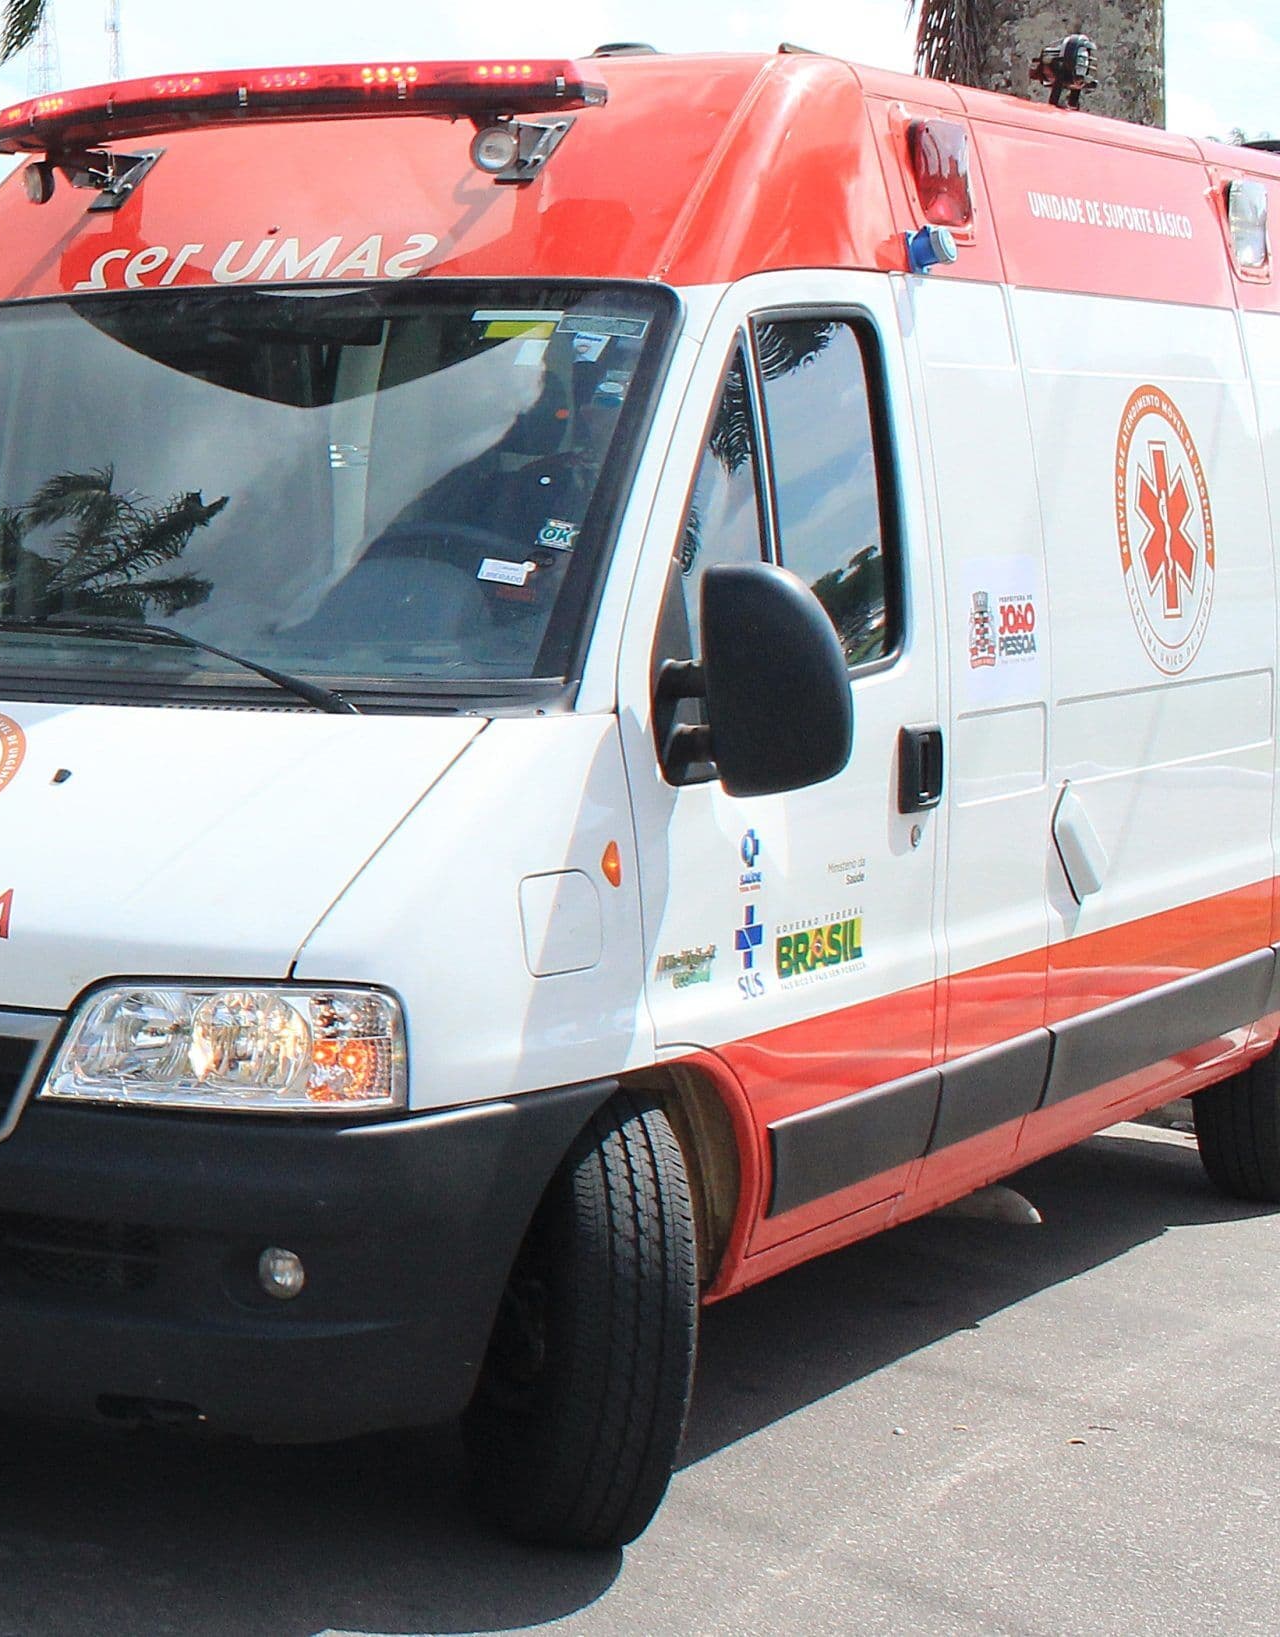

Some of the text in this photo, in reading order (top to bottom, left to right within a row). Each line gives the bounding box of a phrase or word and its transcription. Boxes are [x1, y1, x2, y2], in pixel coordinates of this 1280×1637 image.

[1027, 191, 1193, 239] UNIDADE DE SUPORTE BÁSICO
[1121, 394, 1160, 445] ATENDIMENTO
[1118, 449, 1126, 470] DE
[542, 527, 573, 543] OK
[998, 603, 1035, 635] JOÃO
[998, 634, 1036, 656] PESSOA
[6, 734, 19, 748] DE
[776, 906, 864, 934] GOVERNO FEDERAL
[777, 918, 863, 979] BRASIL
[737, 972, 765, 1000] SUS
